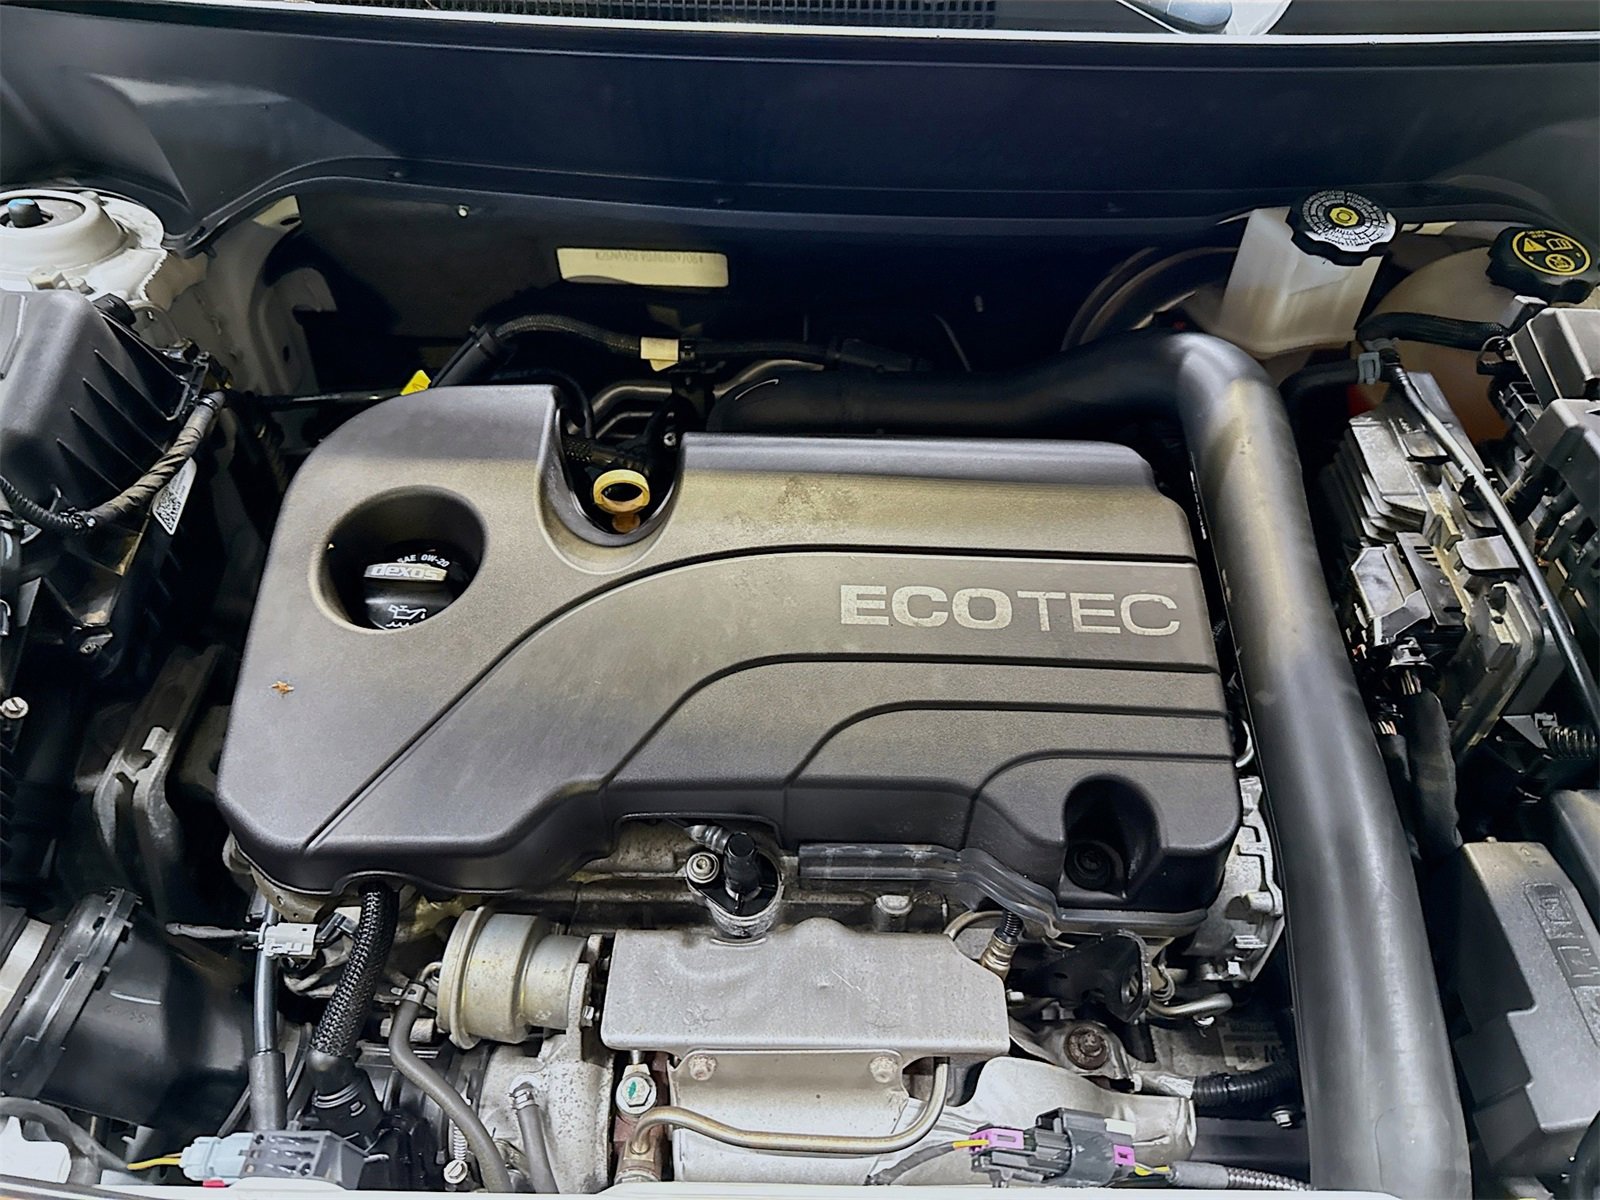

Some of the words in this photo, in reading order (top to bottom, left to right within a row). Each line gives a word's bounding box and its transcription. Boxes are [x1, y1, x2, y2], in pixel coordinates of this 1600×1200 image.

[397, 554, 417, 564] SAE
[421, 554, 450, 567] 0W-20
[371, 564, 437, 579] dexos
[840, 584, 1181, 636] ECOTEC
